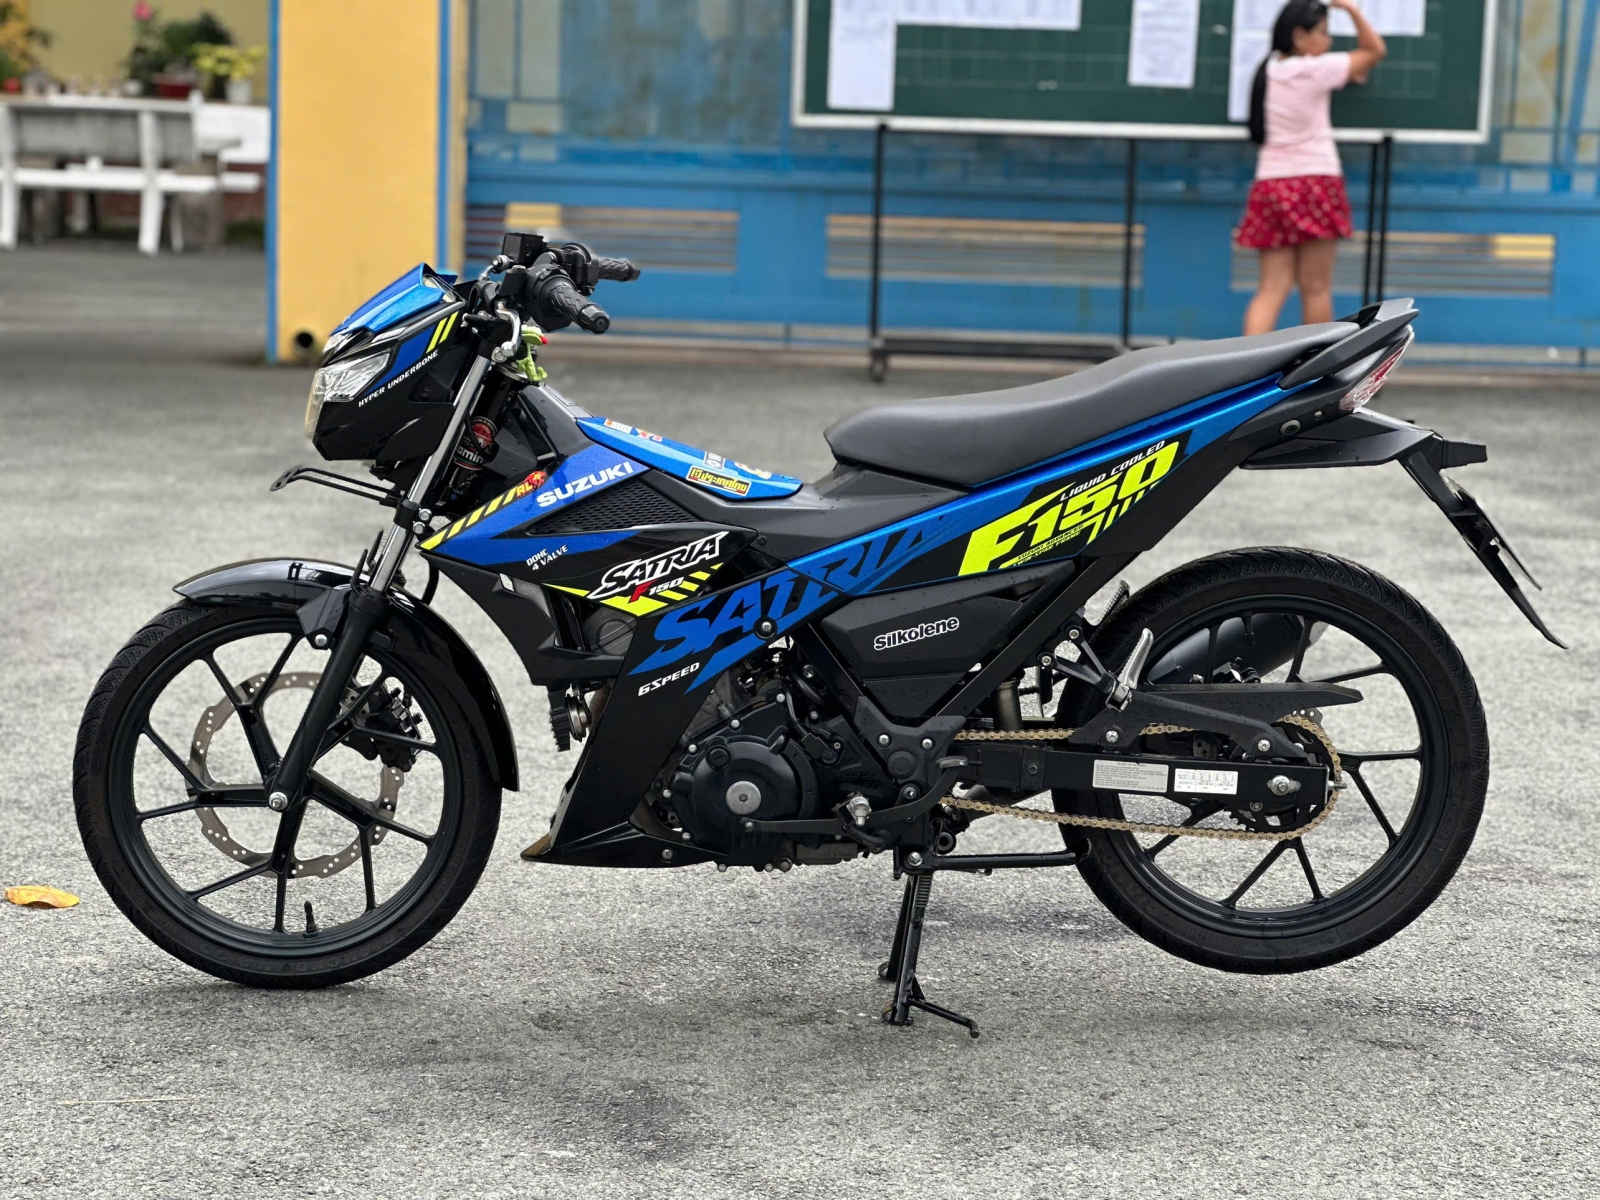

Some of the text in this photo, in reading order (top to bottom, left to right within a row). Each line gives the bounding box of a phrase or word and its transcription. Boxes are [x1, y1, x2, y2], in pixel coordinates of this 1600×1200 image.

[358, 349, 439, 408] HYPER UNDERBONE
[536, 461, 634, 508] SUZUKI
[1060, 440, 1166, 502] LIQUID COOLED
[958, 441, 1179, 576] F150
[526, 548, 548, 566] DOHC
[532, 544, 568, 571] 4 VALVE
[586, 531, 729, 600] SATRIA
[873, 616, 960, 651] Silkolene
[637, 662, 700, 697] 6SPEED
